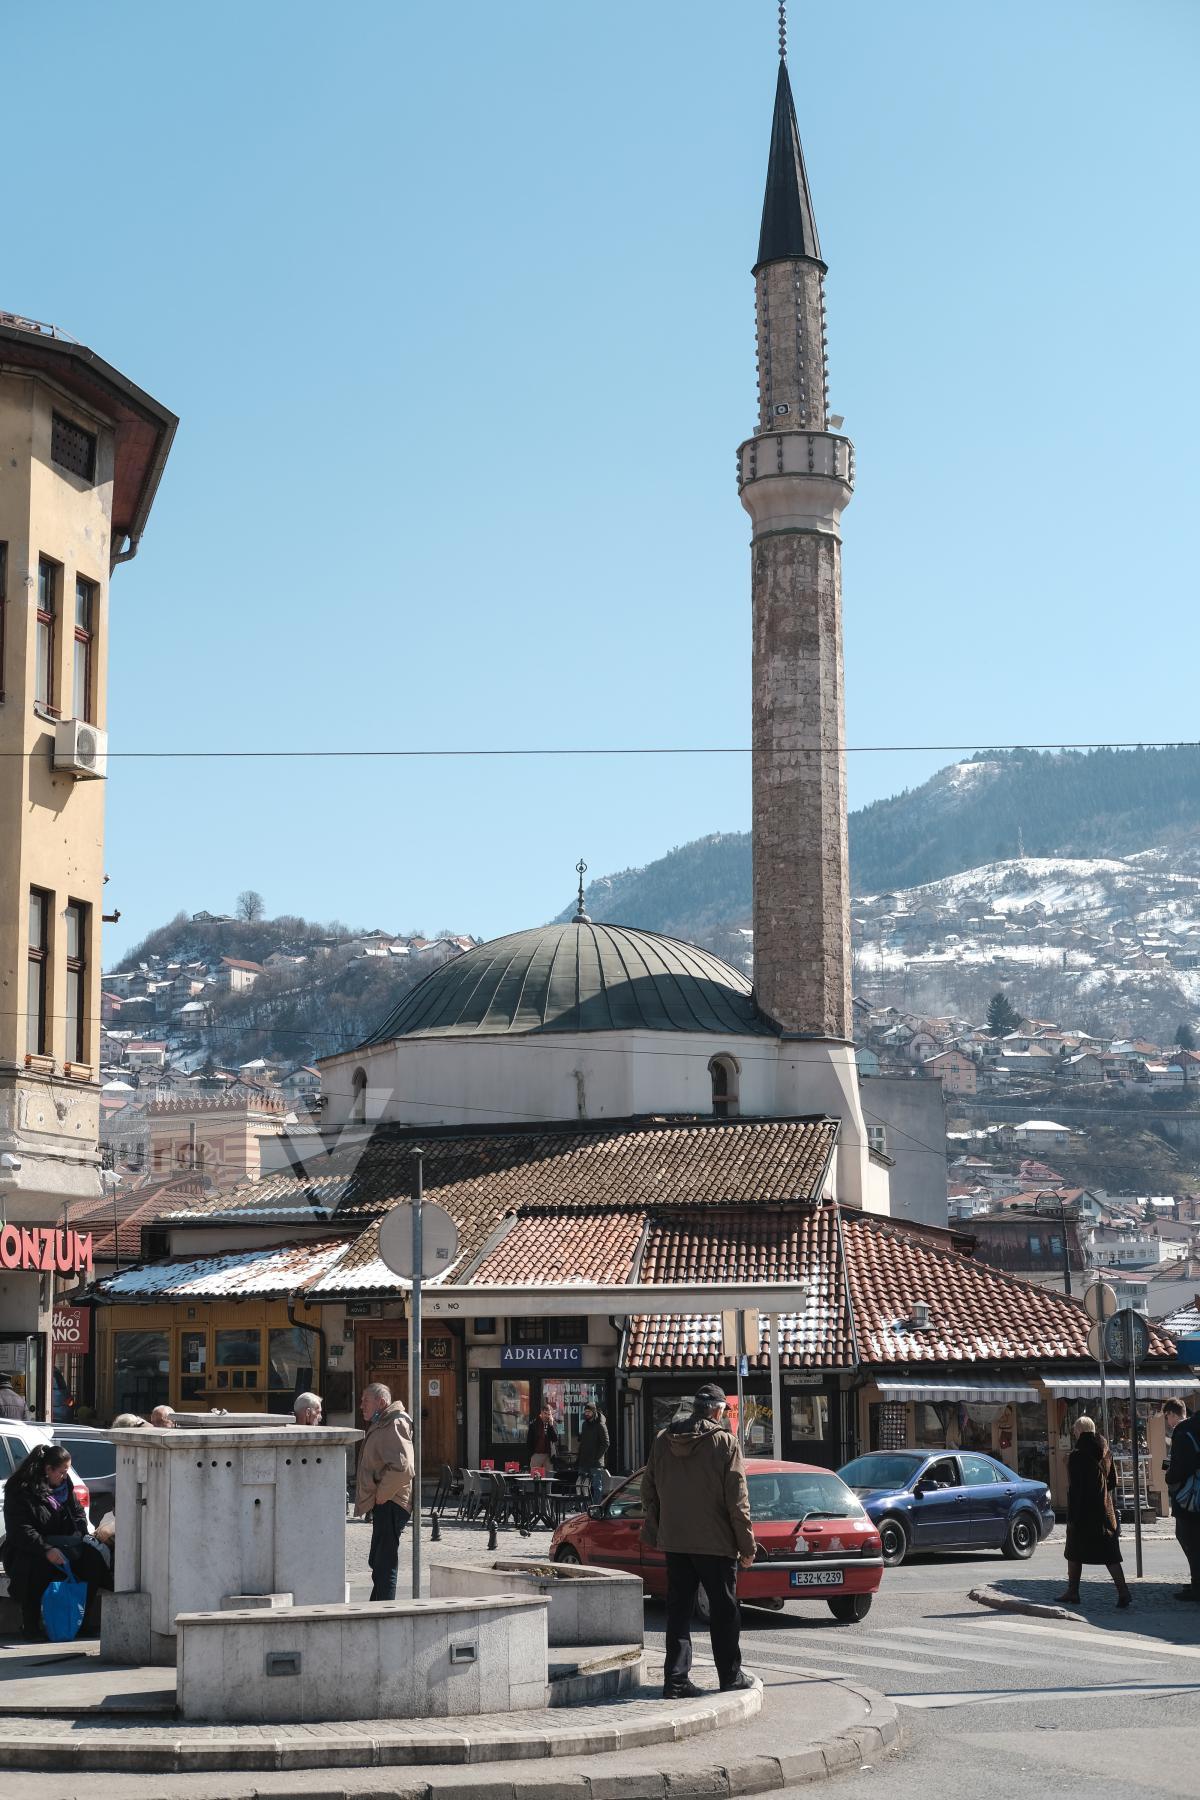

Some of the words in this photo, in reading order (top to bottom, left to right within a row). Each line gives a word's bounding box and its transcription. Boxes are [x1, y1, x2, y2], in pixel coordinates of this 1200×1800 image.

[0, 1223, 93, 1272] ONZUM
[52, 1311, 74, 1327] tko
[503, 1347, 579, 1360] ADRIATIC
[797, 1572, 842, 1584] E32-K-239
